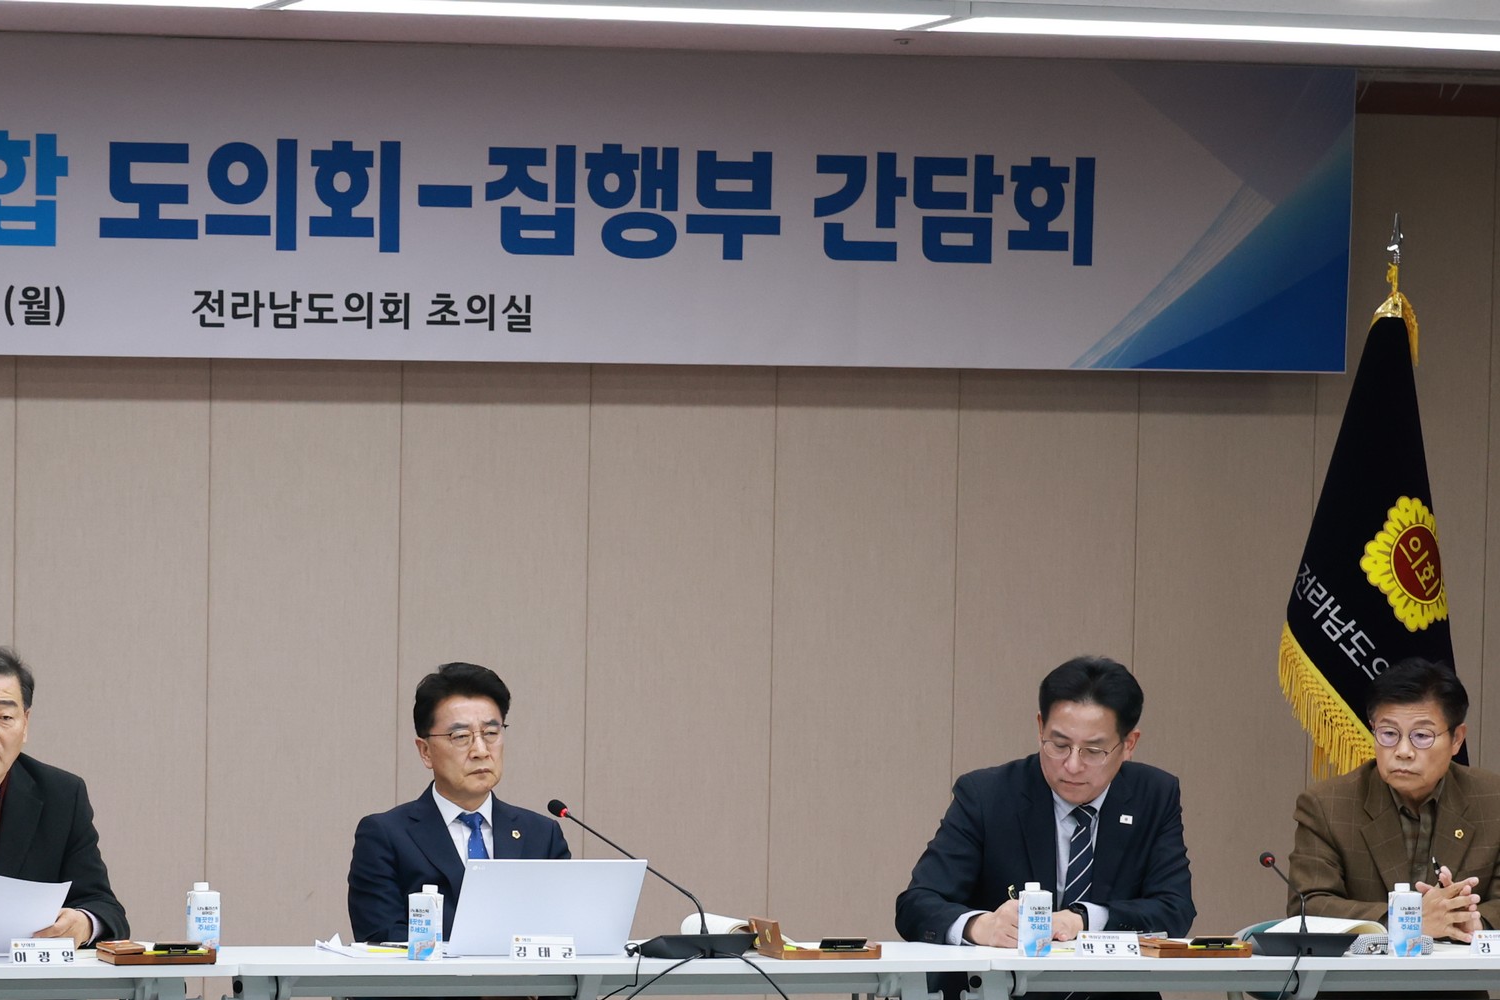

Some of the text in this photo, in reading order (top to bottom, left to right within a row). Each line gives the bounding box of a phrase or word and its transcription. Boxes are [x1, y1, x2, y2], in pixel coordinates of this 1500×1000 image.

[812, 150, 1097, 267] 간담회
[191, 289, 532, 334] 전라남도의회 초의실
[1398, 536, 1440, 597] 의회
